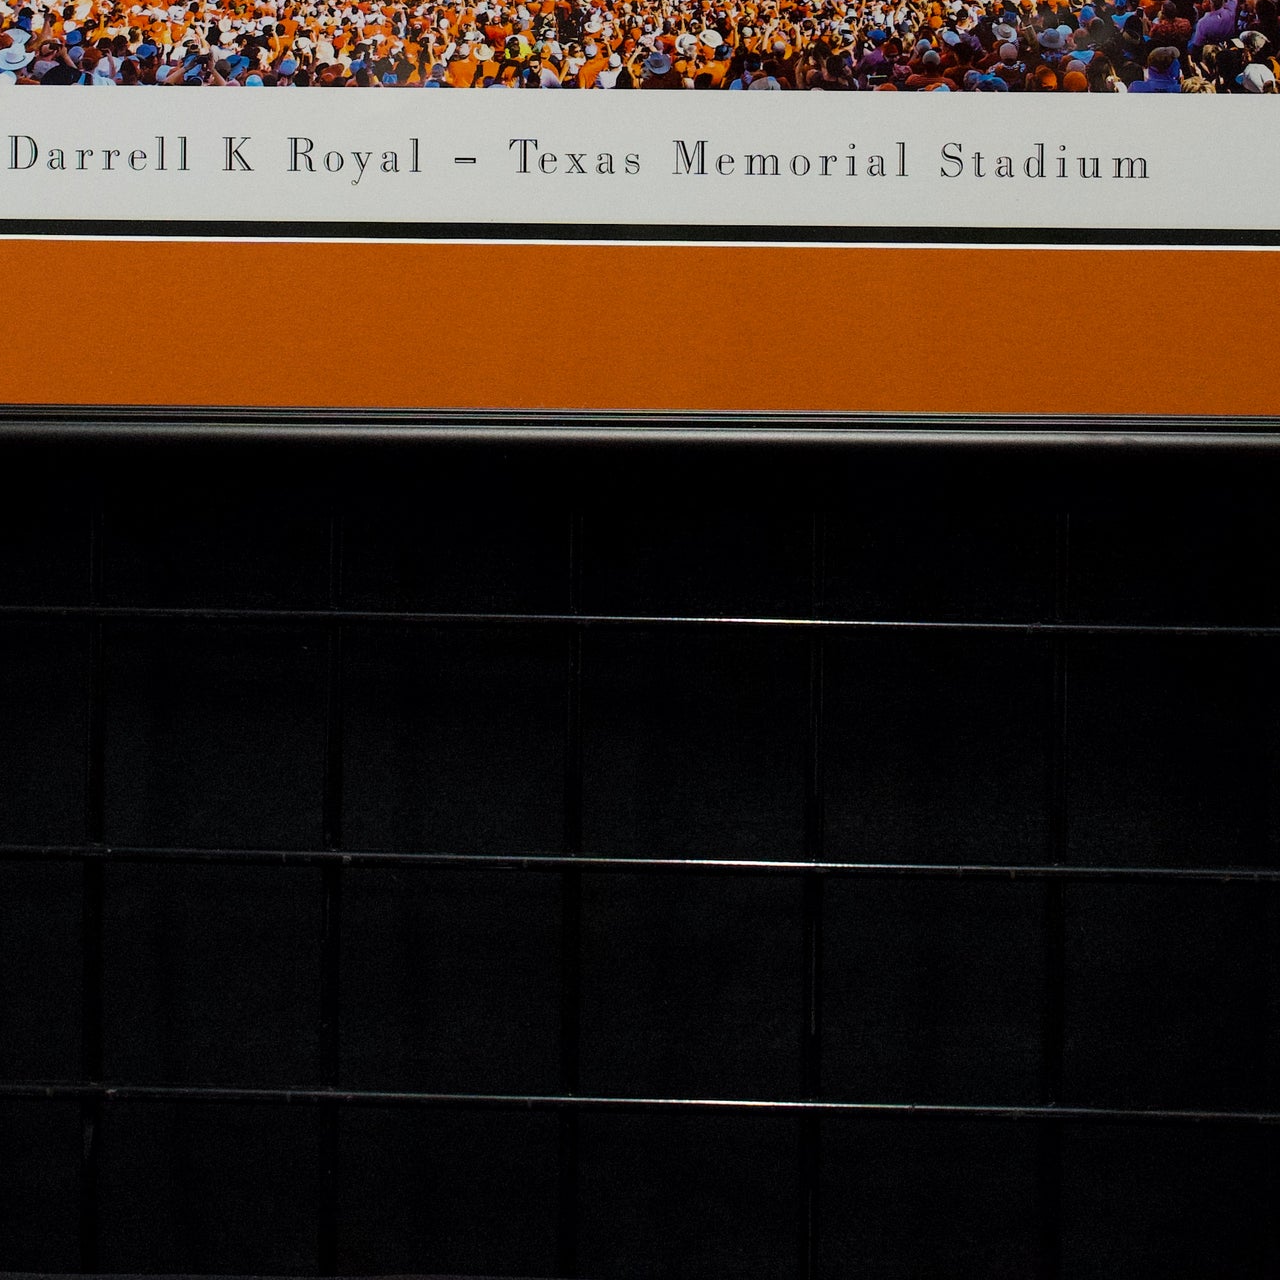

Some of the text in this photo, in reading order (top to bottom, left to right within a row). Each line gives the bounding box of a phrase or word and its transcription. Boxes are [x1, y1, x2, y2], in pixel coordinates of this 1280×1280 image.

[7, 134, 192, 172] Darrell
[221, 136, 255, 173] K
[286, 136, 423, 186] Royal
[508, 138, 643, 176] Texas
[672, 139, 910, 178] Memorial
[939, 140, 1151, 179] Stadium
